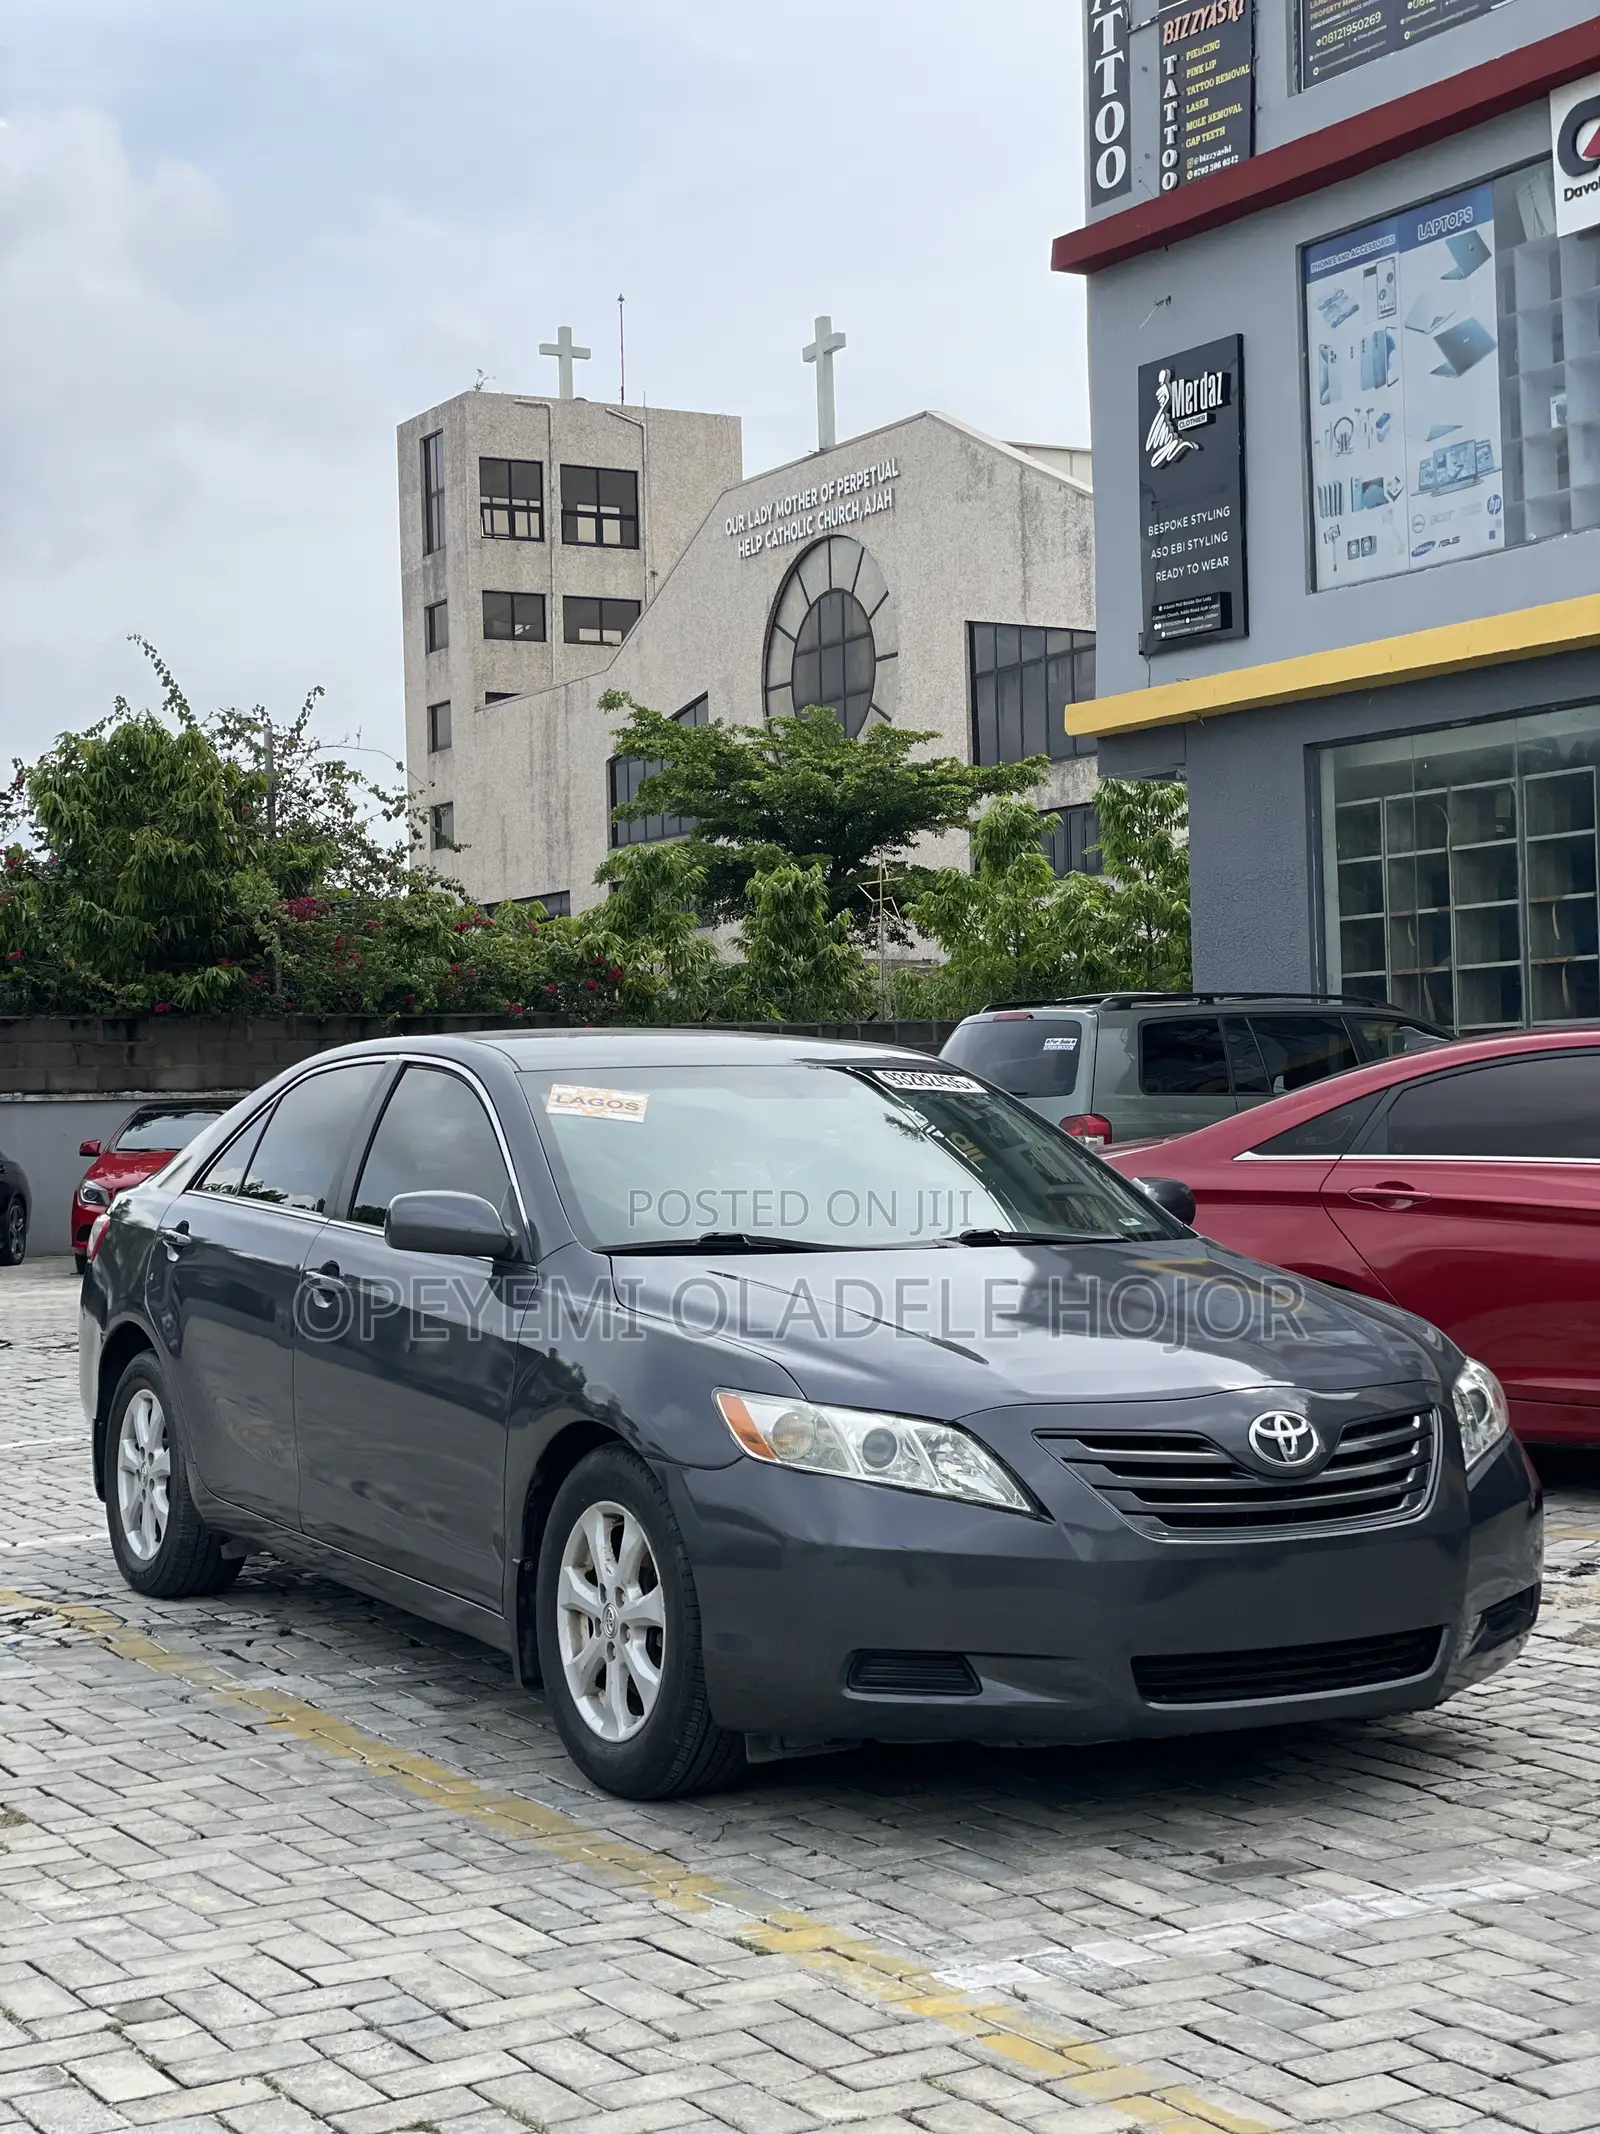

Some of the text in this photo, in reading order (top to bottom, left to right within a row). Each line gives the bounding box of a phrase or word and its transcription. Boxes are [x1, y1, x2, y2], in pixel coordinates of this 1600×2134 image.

[1321, 11, 1382, 46] 08121950269
[1186, 40, 1220, 60] PIERCING
[1186, 59, 1217, 79] PINK LIP
[1186, 64, 1250, 96] TATTOO REMOVAL
[1091, 0, 1126, 189] TTOO
[1186, 98, 1209, 114] LASER
[1186, 103, 1243, 132] MOLE REMOVAL
[1186, 126, 1226, 148] GAP TEETH
[1564, 176, 1600, 202] Davo
[1417, 206, 1474, 242] LAPTOPS
[1310, 234, 1396, 274] PHONES AND ACCESSORIES
[1171, 371, 1223, 419] Merdaz
[725, 457, 899, 536] OUR LADY MOTHER OF PERPETUAL
[1148, 506, 1230, 536] BESPOKE STYLING
[738, 535, 763, 559] HELP
[765, 516, 814, 549] CATHOLIC
[1150, 531, 1229, 560] ASO EBI STYLING
[1156, 556, 1229, 582] READY TO WEAR
[556, 1094, 640, 1111] LAGOS
